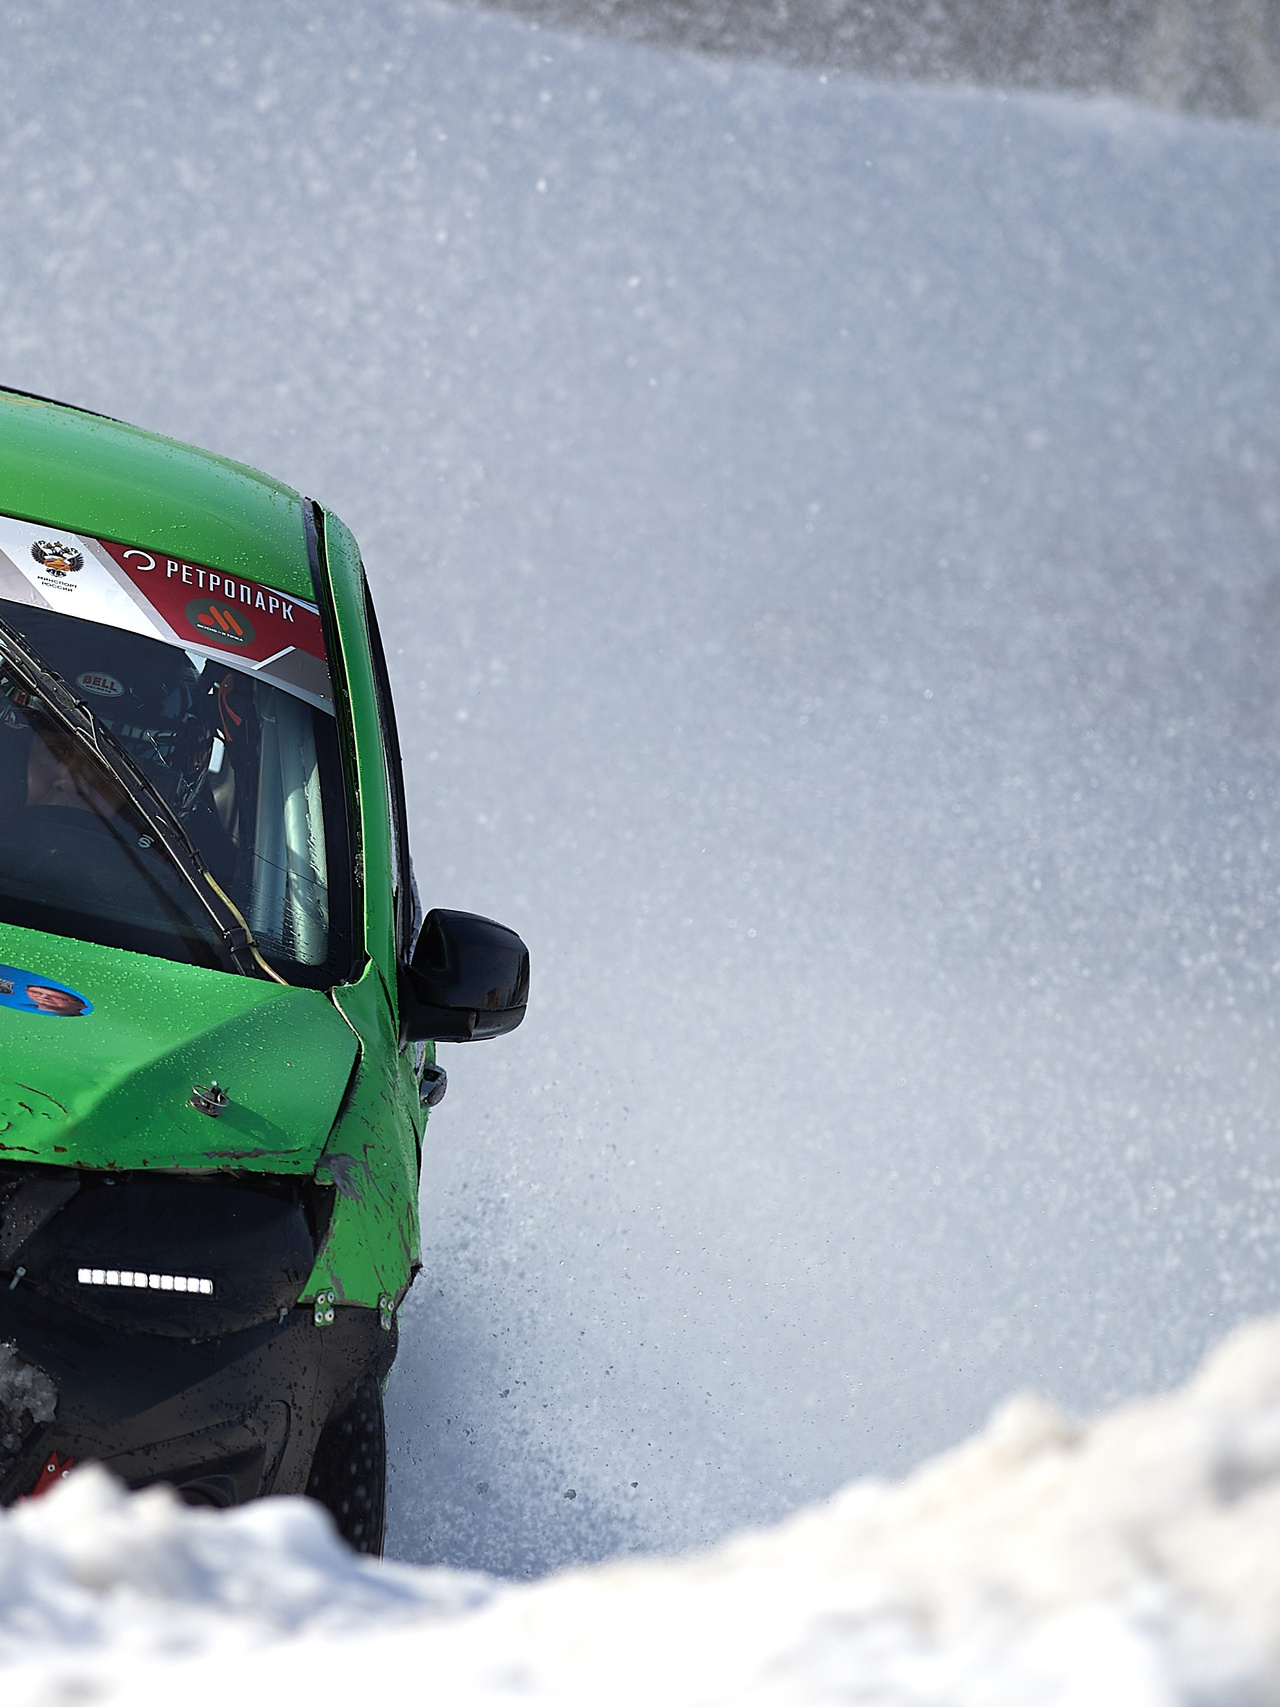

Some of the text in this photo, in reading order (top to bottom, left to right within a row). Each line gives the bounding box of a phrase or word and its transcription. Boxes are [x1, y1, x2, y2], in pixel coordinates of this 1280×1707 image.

[37, 575, 77, 589] МИНСПОРТ
[41, 581, 73, 592] РОССИИ
[166, 559, 295, 623] РЕТРОПАРК
[83, 675, 118, 692] BELL
